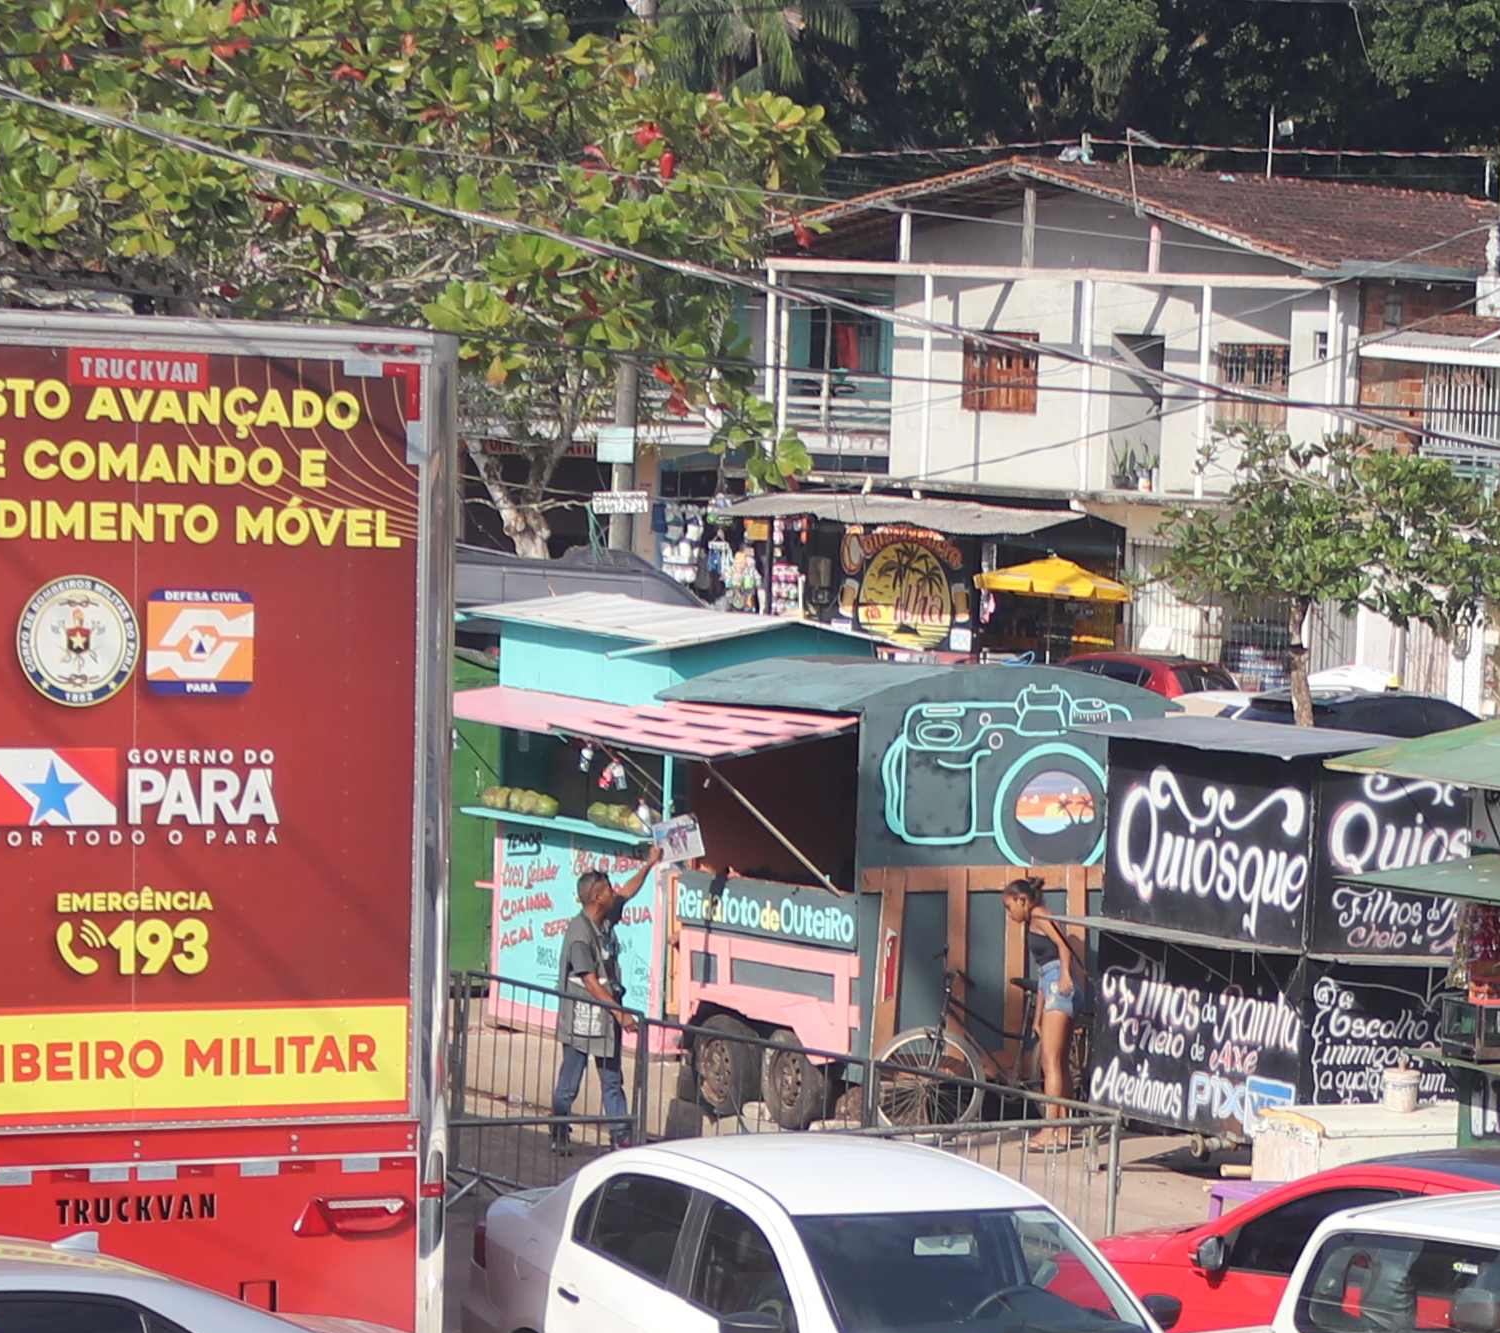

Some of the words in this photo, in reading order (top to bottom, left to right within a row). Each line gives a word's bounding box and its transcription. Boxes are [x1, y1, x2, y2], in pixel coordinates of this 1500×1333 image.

[79, 355, 198, 384] TRUCKVAN
[84, 385, 360, 439] AVANÇADO
[22, 439, 284, 487] COMANDO
[299, 448, 328, 488] E
[234, 496, 403, 549] MÓVEL
[30, 578, 92, 613] BOMBEIROS
[93, 582, 129, 624] MILITAR
[164, 590, 210, 602] DEFESA
[211, 590, 242, 603] CIVIL
[127, 749, 235, 765] GOVERNO
[243, 749, 276, 765] DO
[127, 767, 280, 826] PARÁ
[66, 829, 146, 846] TODO
[168, 828, 184, 846] O
[205, 827, 279, 846] PARÁ
[1329, 800, 1472, 874] Quios
[1116, 785, 1308, 938] Quiosque
[57, 886, 214, 912] EMERGÊNCIA
[676, 883, 706, 920] Rei
[721, 893, 762, 929] foto
[760, 905, 780, 931] de
[1332, 886, 1423, 928] Filhos
[107, 917, 211, 976] 193
[1346, 923, 1408, 949] Cheio
[183, 1033, 379, 1079] MILITAR
[1090, 1056, 1183, 1119] Aceitamos
[56, 1192, 218, 1226] TRUCKVAN
